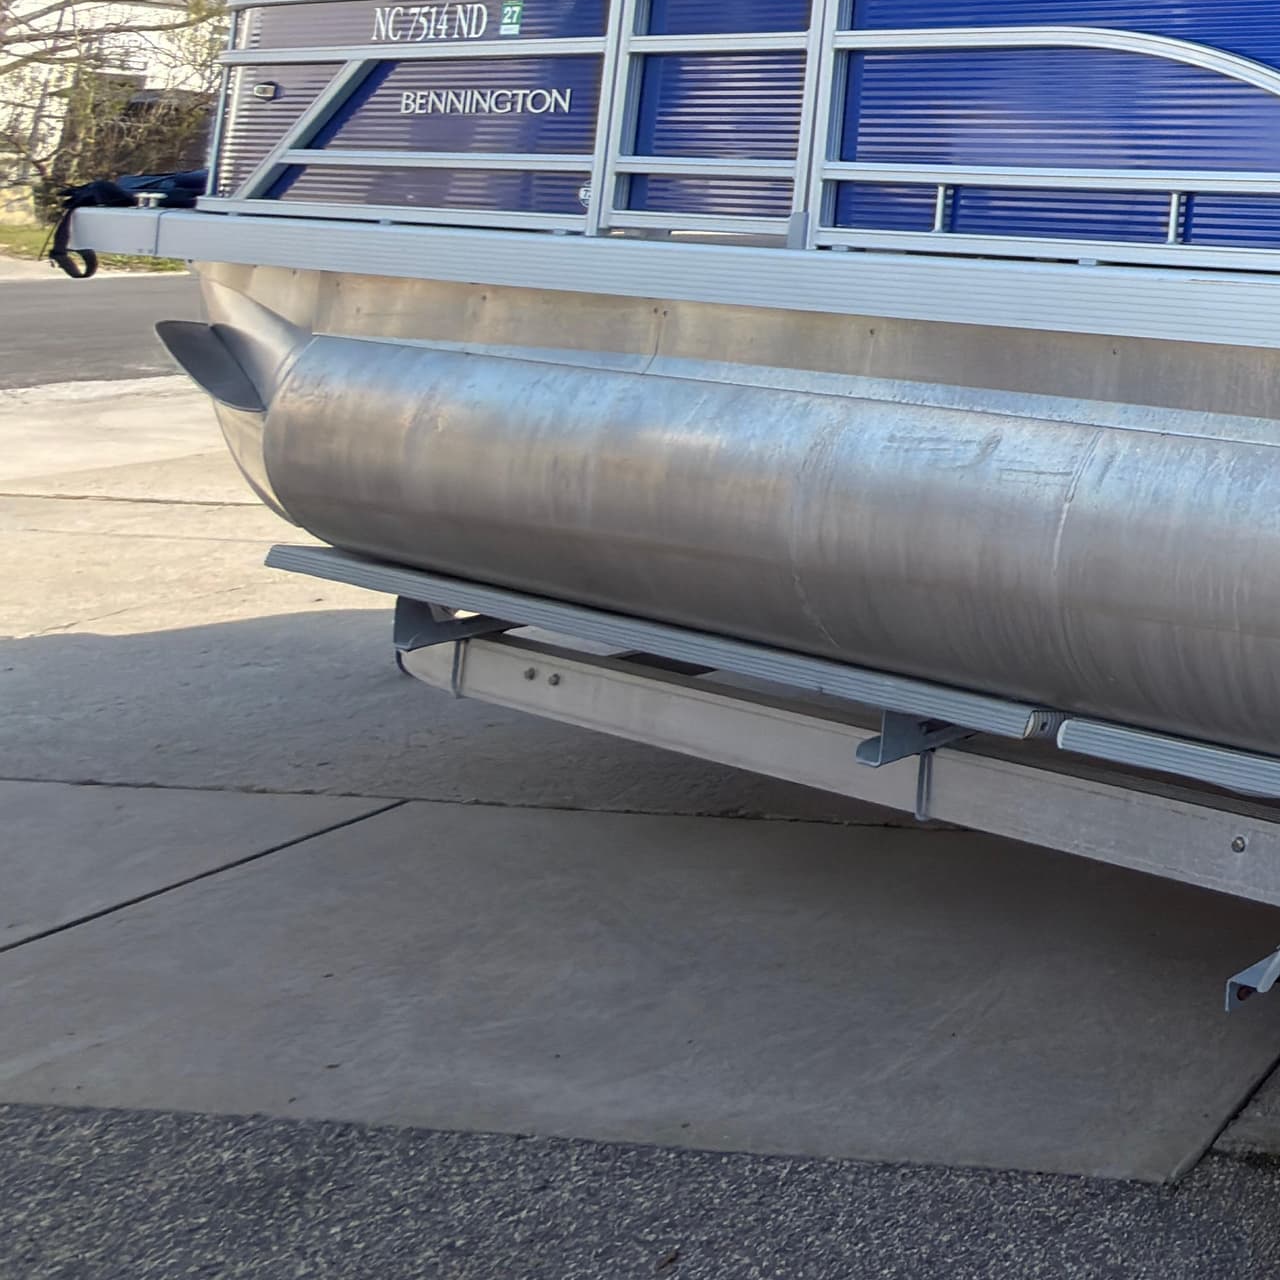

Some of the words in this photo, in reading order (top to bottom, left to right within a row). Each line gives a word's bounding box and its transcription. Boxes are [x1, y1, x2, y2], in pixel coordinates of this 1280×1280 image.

[371, 6, 403, 41] NC
[407, 2, 449, 41] 7514
[452, 3, 488, 38] ND
[502, 6, 521, 24] 27
[400, 88, 572, 114] BENNINGTON
